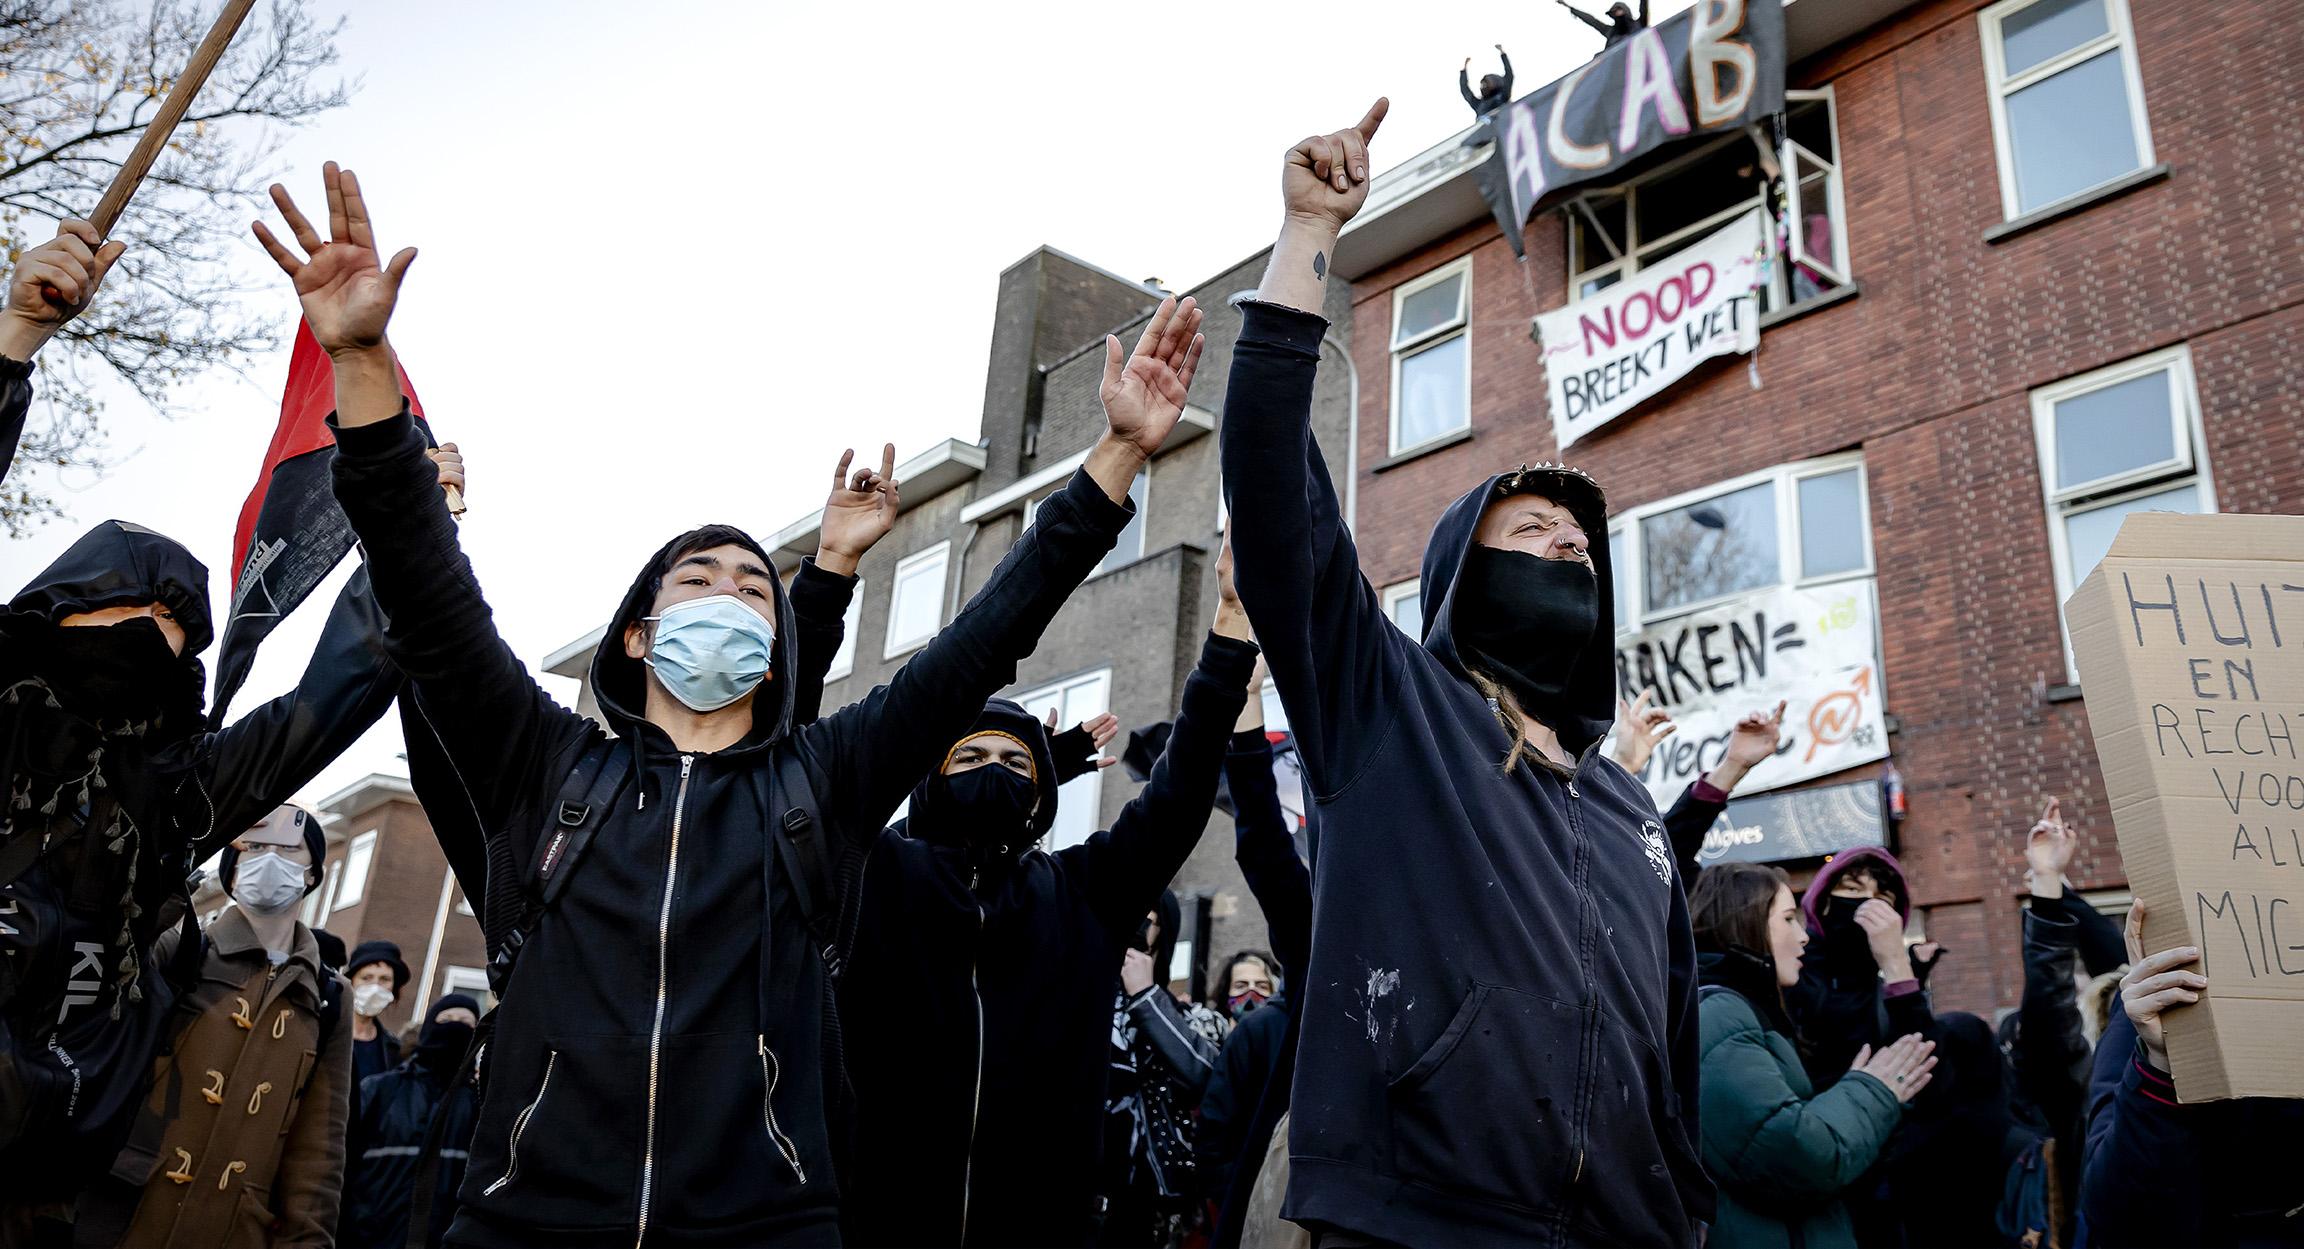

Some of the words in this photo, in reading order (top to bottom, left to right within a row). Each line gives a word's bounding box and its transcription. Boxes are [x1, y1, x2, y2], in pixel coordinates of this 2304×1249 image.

[1505, 0, 1757, 230] ACAB
[1579, 260, 1716, 357] NOOD
[1562, 331, 1676, 421] BREEKT
[1685, 296, 1752, 353] WET
[1616, 610, 1805, 706] RAKEN=
[2188, 657, 2260, 700] EN
[2152, 703, 2304, 760] RECH
[541, 831, 564, 871] EASTPAK
[57, 941, 104, 1025] KIL
